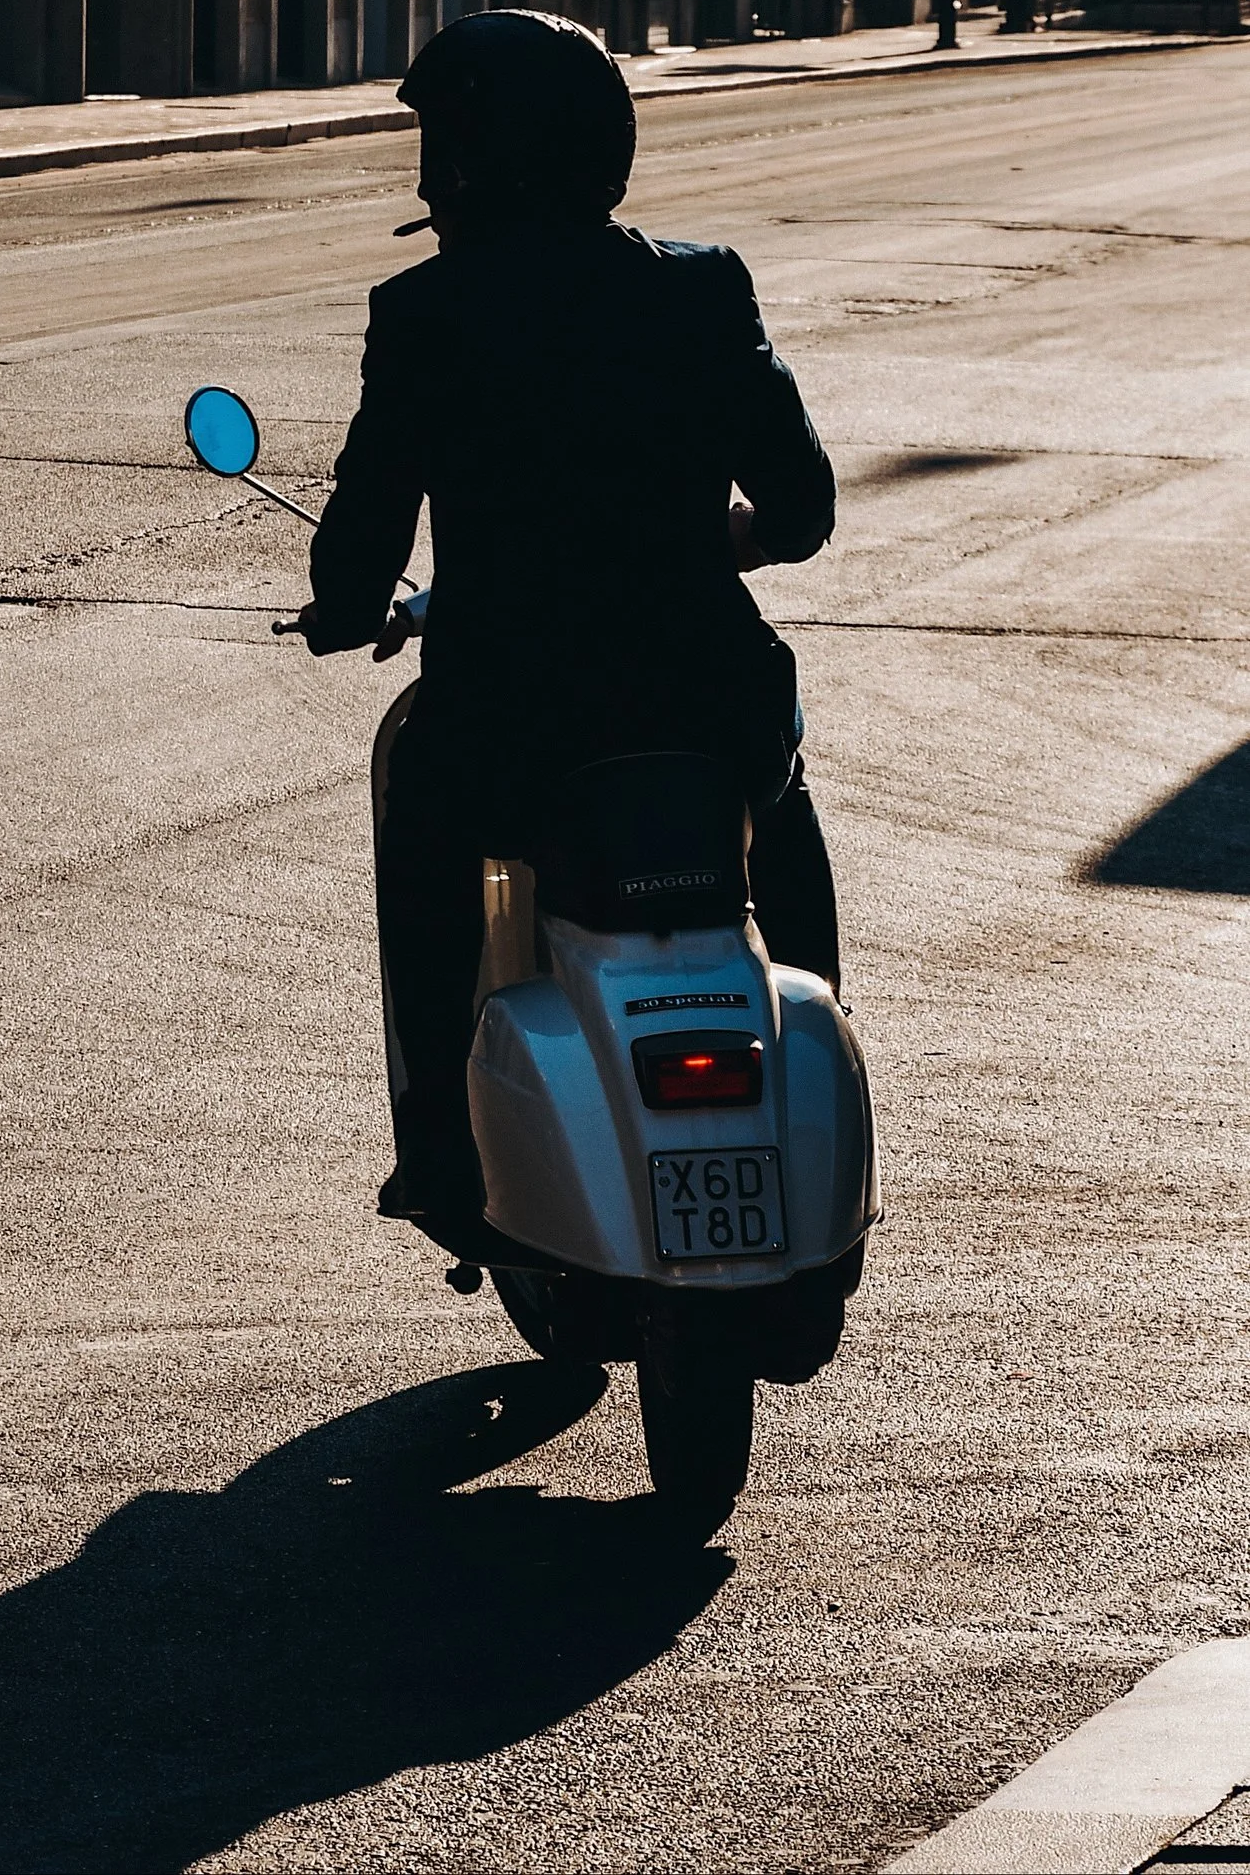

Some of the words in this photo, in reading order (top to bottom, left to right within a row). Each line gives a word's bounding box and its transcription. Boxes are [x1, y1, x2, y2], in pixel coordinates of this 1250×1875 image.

[624, 874, 716, 894] PIAGGIO
[638, 999, 660, 1009] 50
[665, 994, 736, 1006] special
[669, 1157, 764, 1203] X6D
[671, 1205, 767, 1251] T8D
